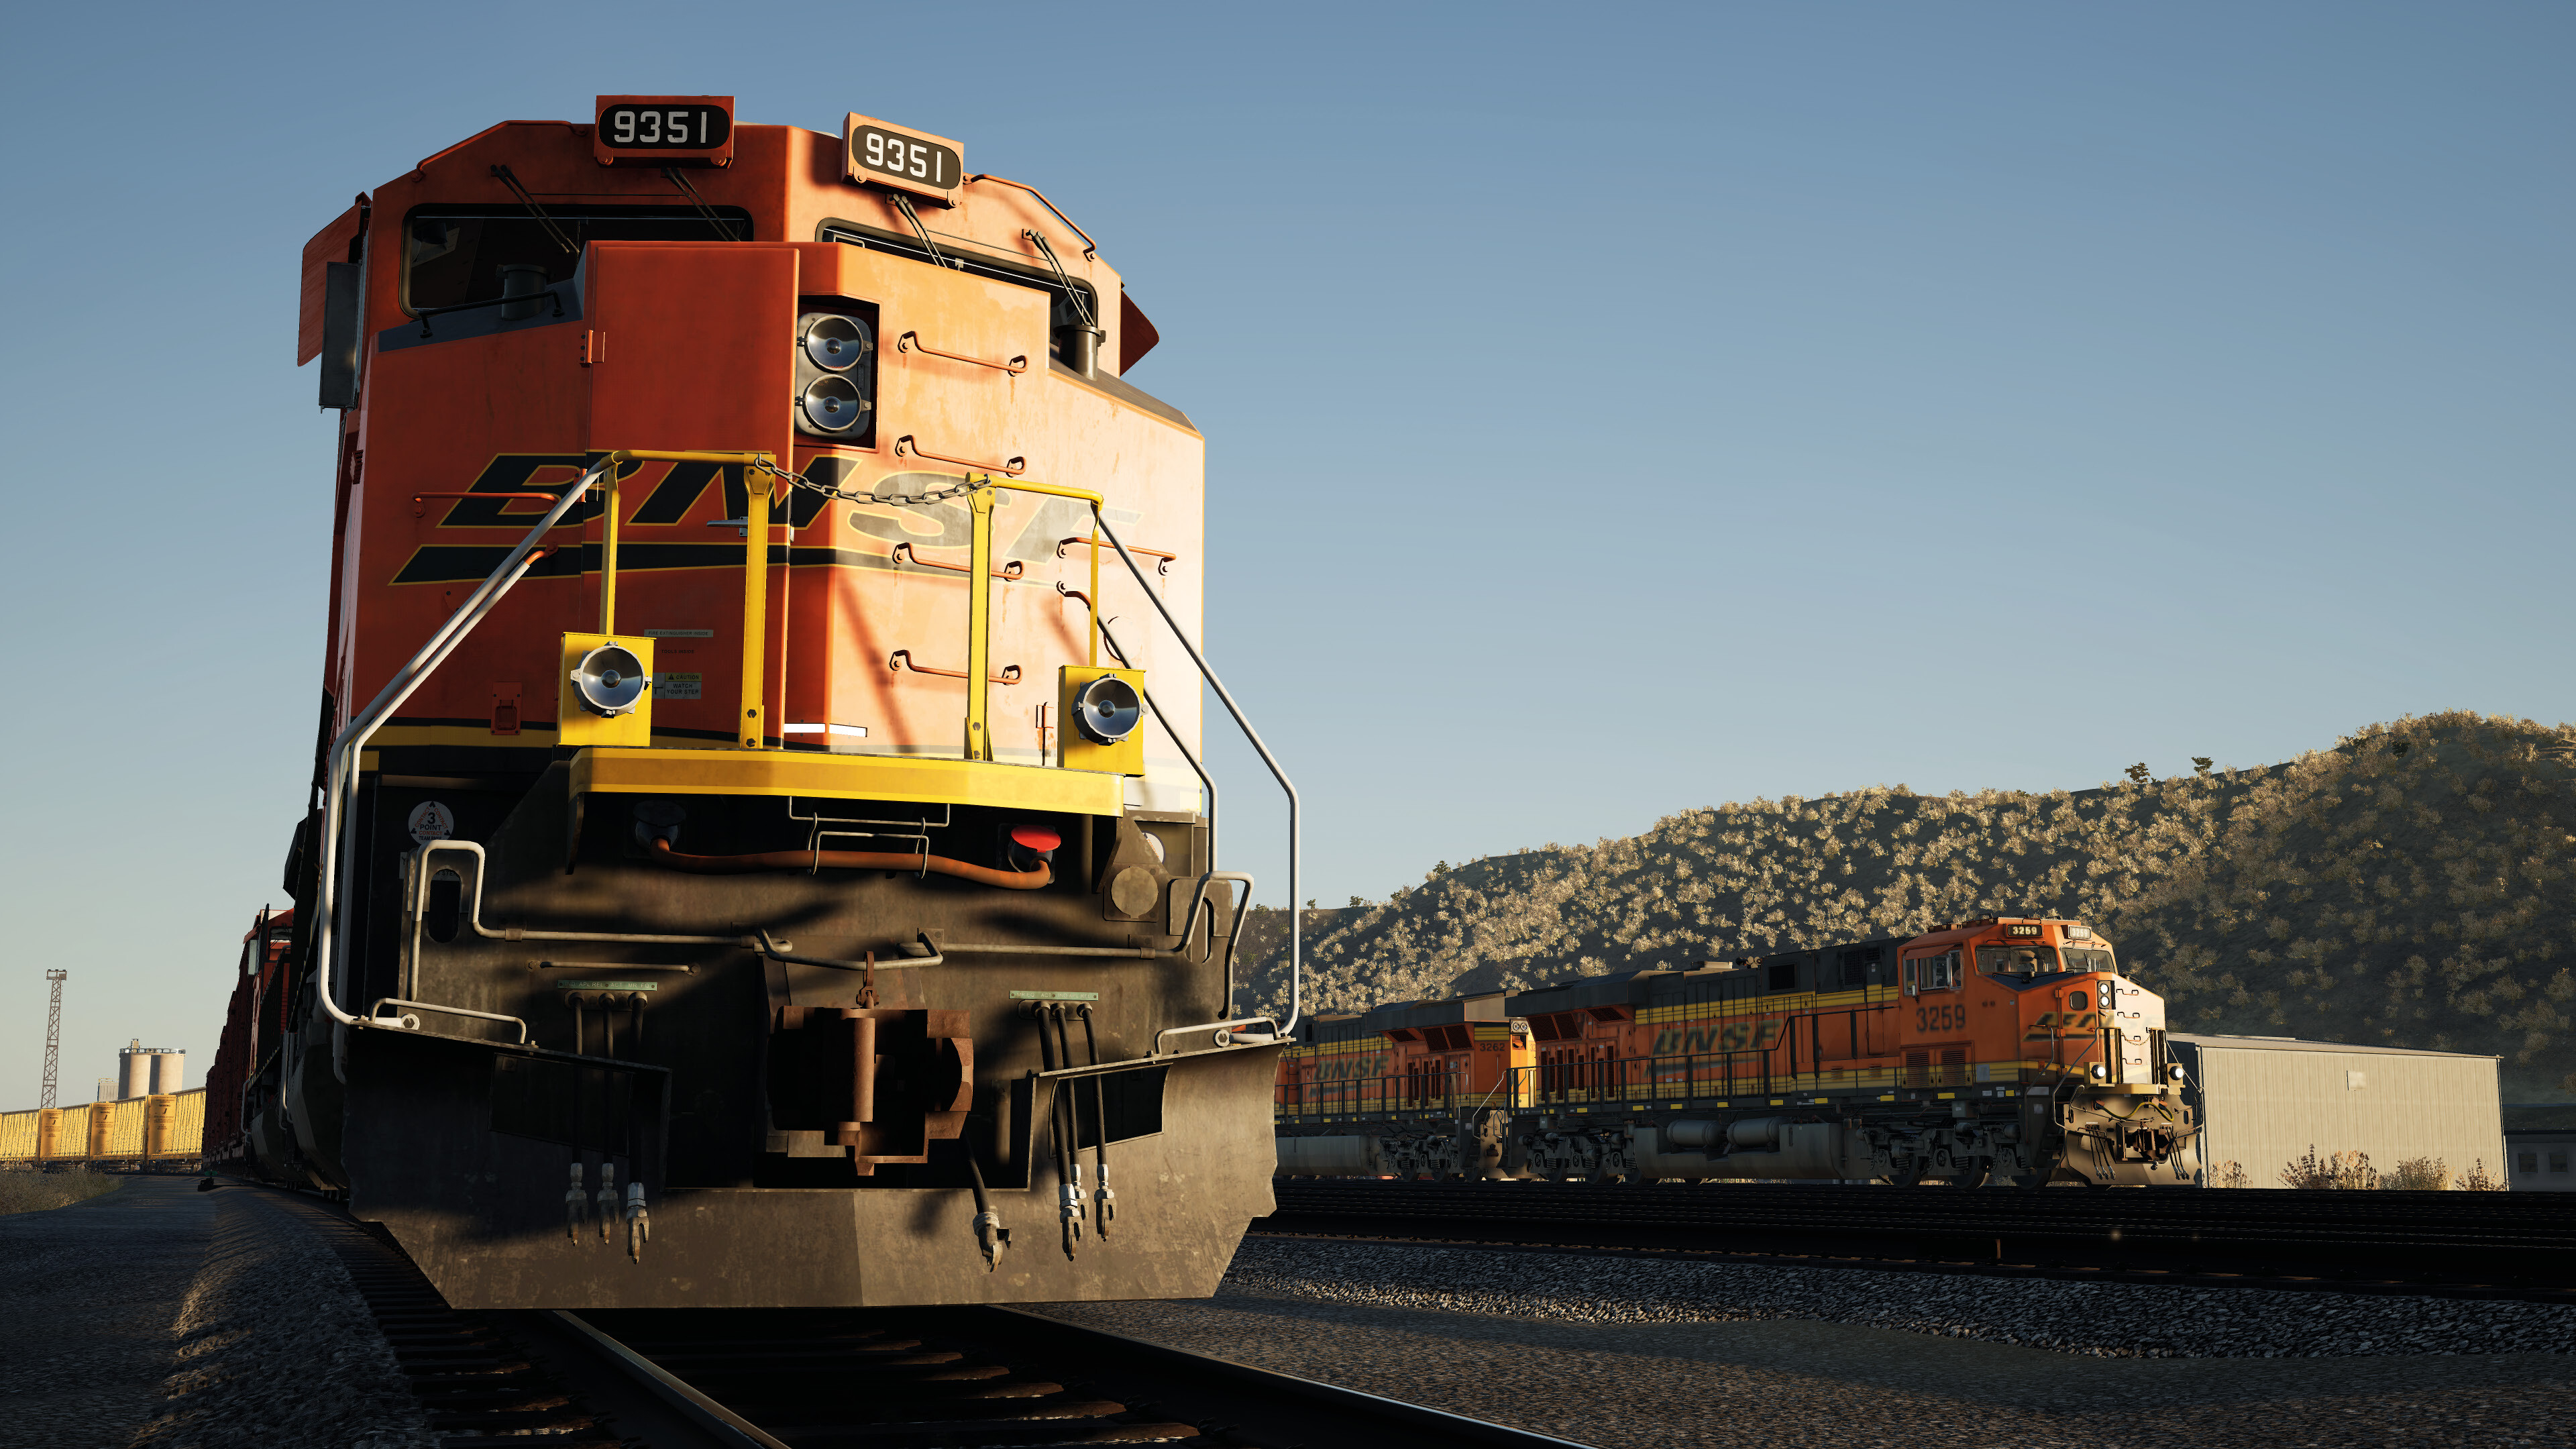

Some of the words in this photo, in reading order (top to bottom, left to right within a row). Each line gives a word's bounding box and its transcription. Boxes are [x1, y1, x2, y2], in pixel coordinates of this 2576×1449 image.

[614, 111, 707, 144] 9351
[865, 132, 943, 182] 9351
[436, 451, 1144, 565] BNSF
[415, 806, 431, 828] CONTACT
[427, 812, 435, 824] 3
[434, 808, 449, 829] CONTACT
[1480, 1042, 1505, 1052] 3262
